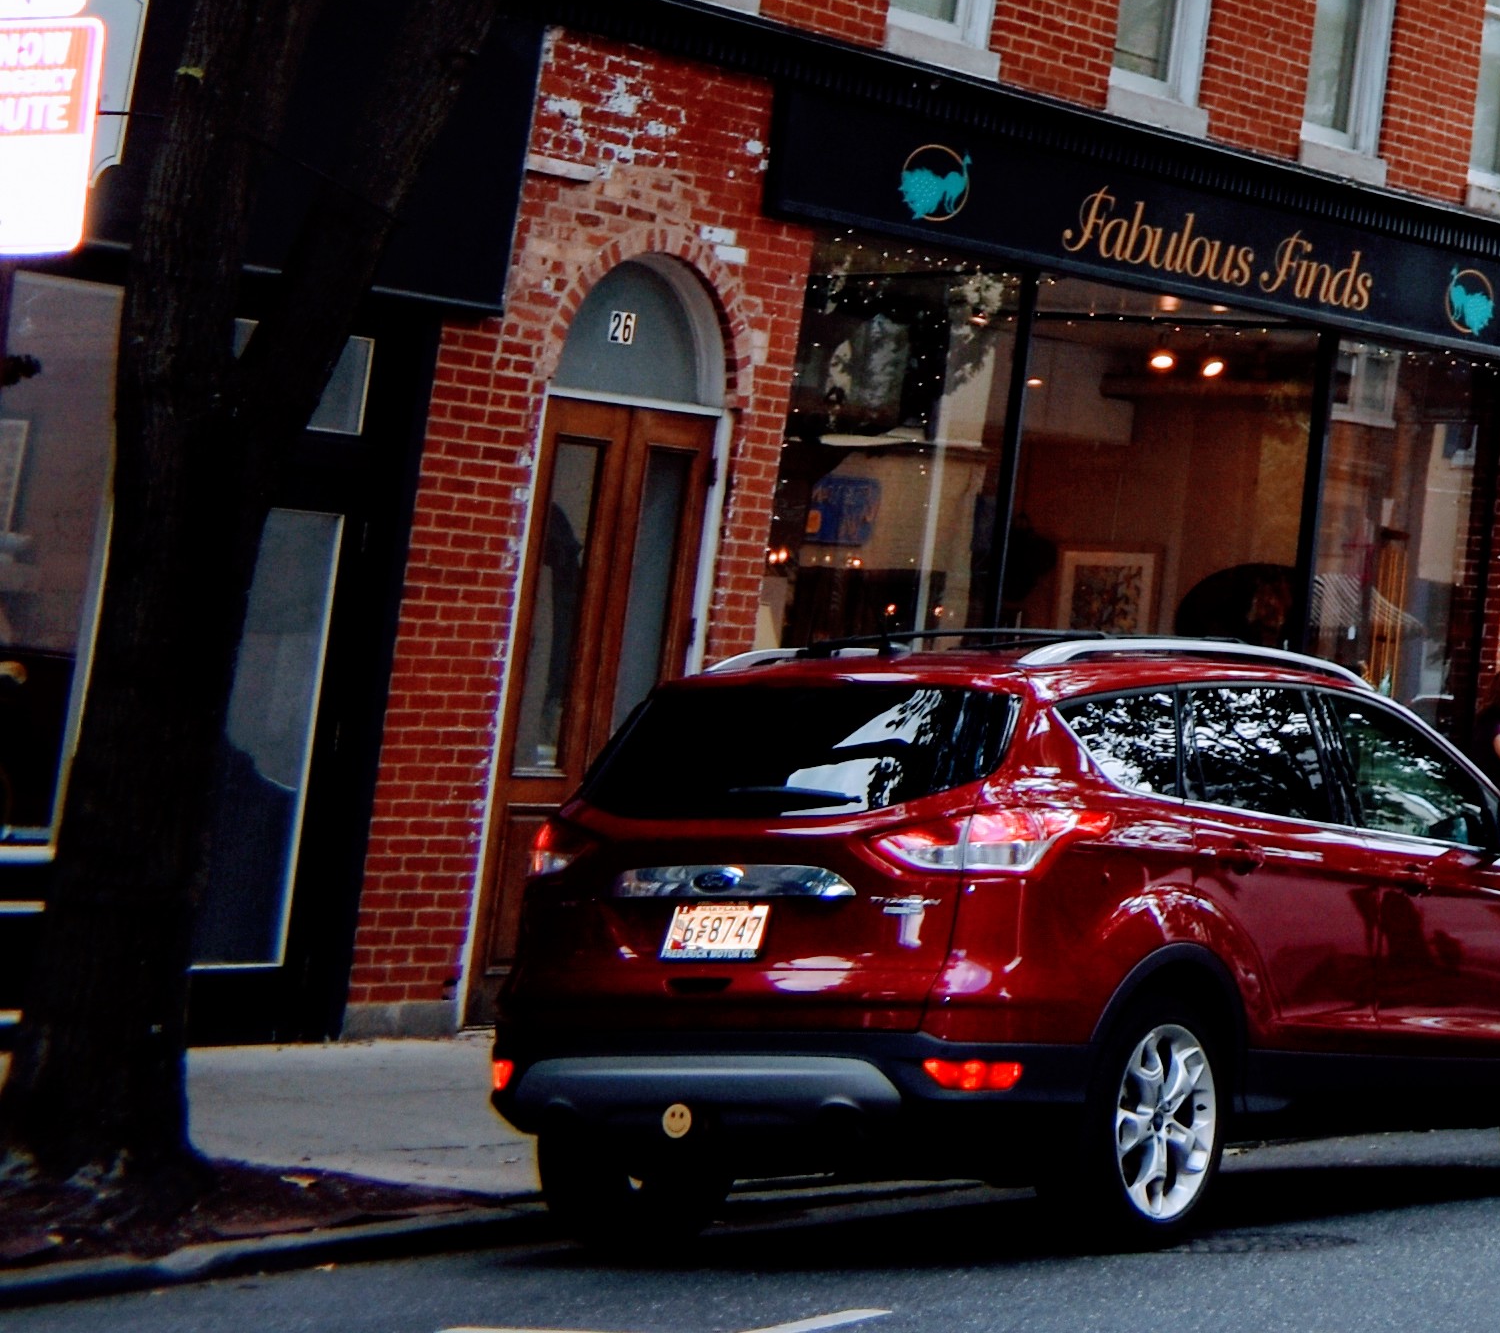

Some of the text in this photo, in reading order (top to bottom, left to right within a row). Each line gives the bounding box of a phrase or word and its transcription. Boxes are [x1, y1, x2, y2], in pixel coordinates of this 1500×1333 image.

[0, 31, 72, 67] NOW
[0, 96, 71, 132] UTE
[1062, 185, 1372, 311] Fabulous Finds
[610, 313, 632, 342] 26
[661, 949, 708, 958] FREDERICK
[710, 949, 740, 958] MOTOR
